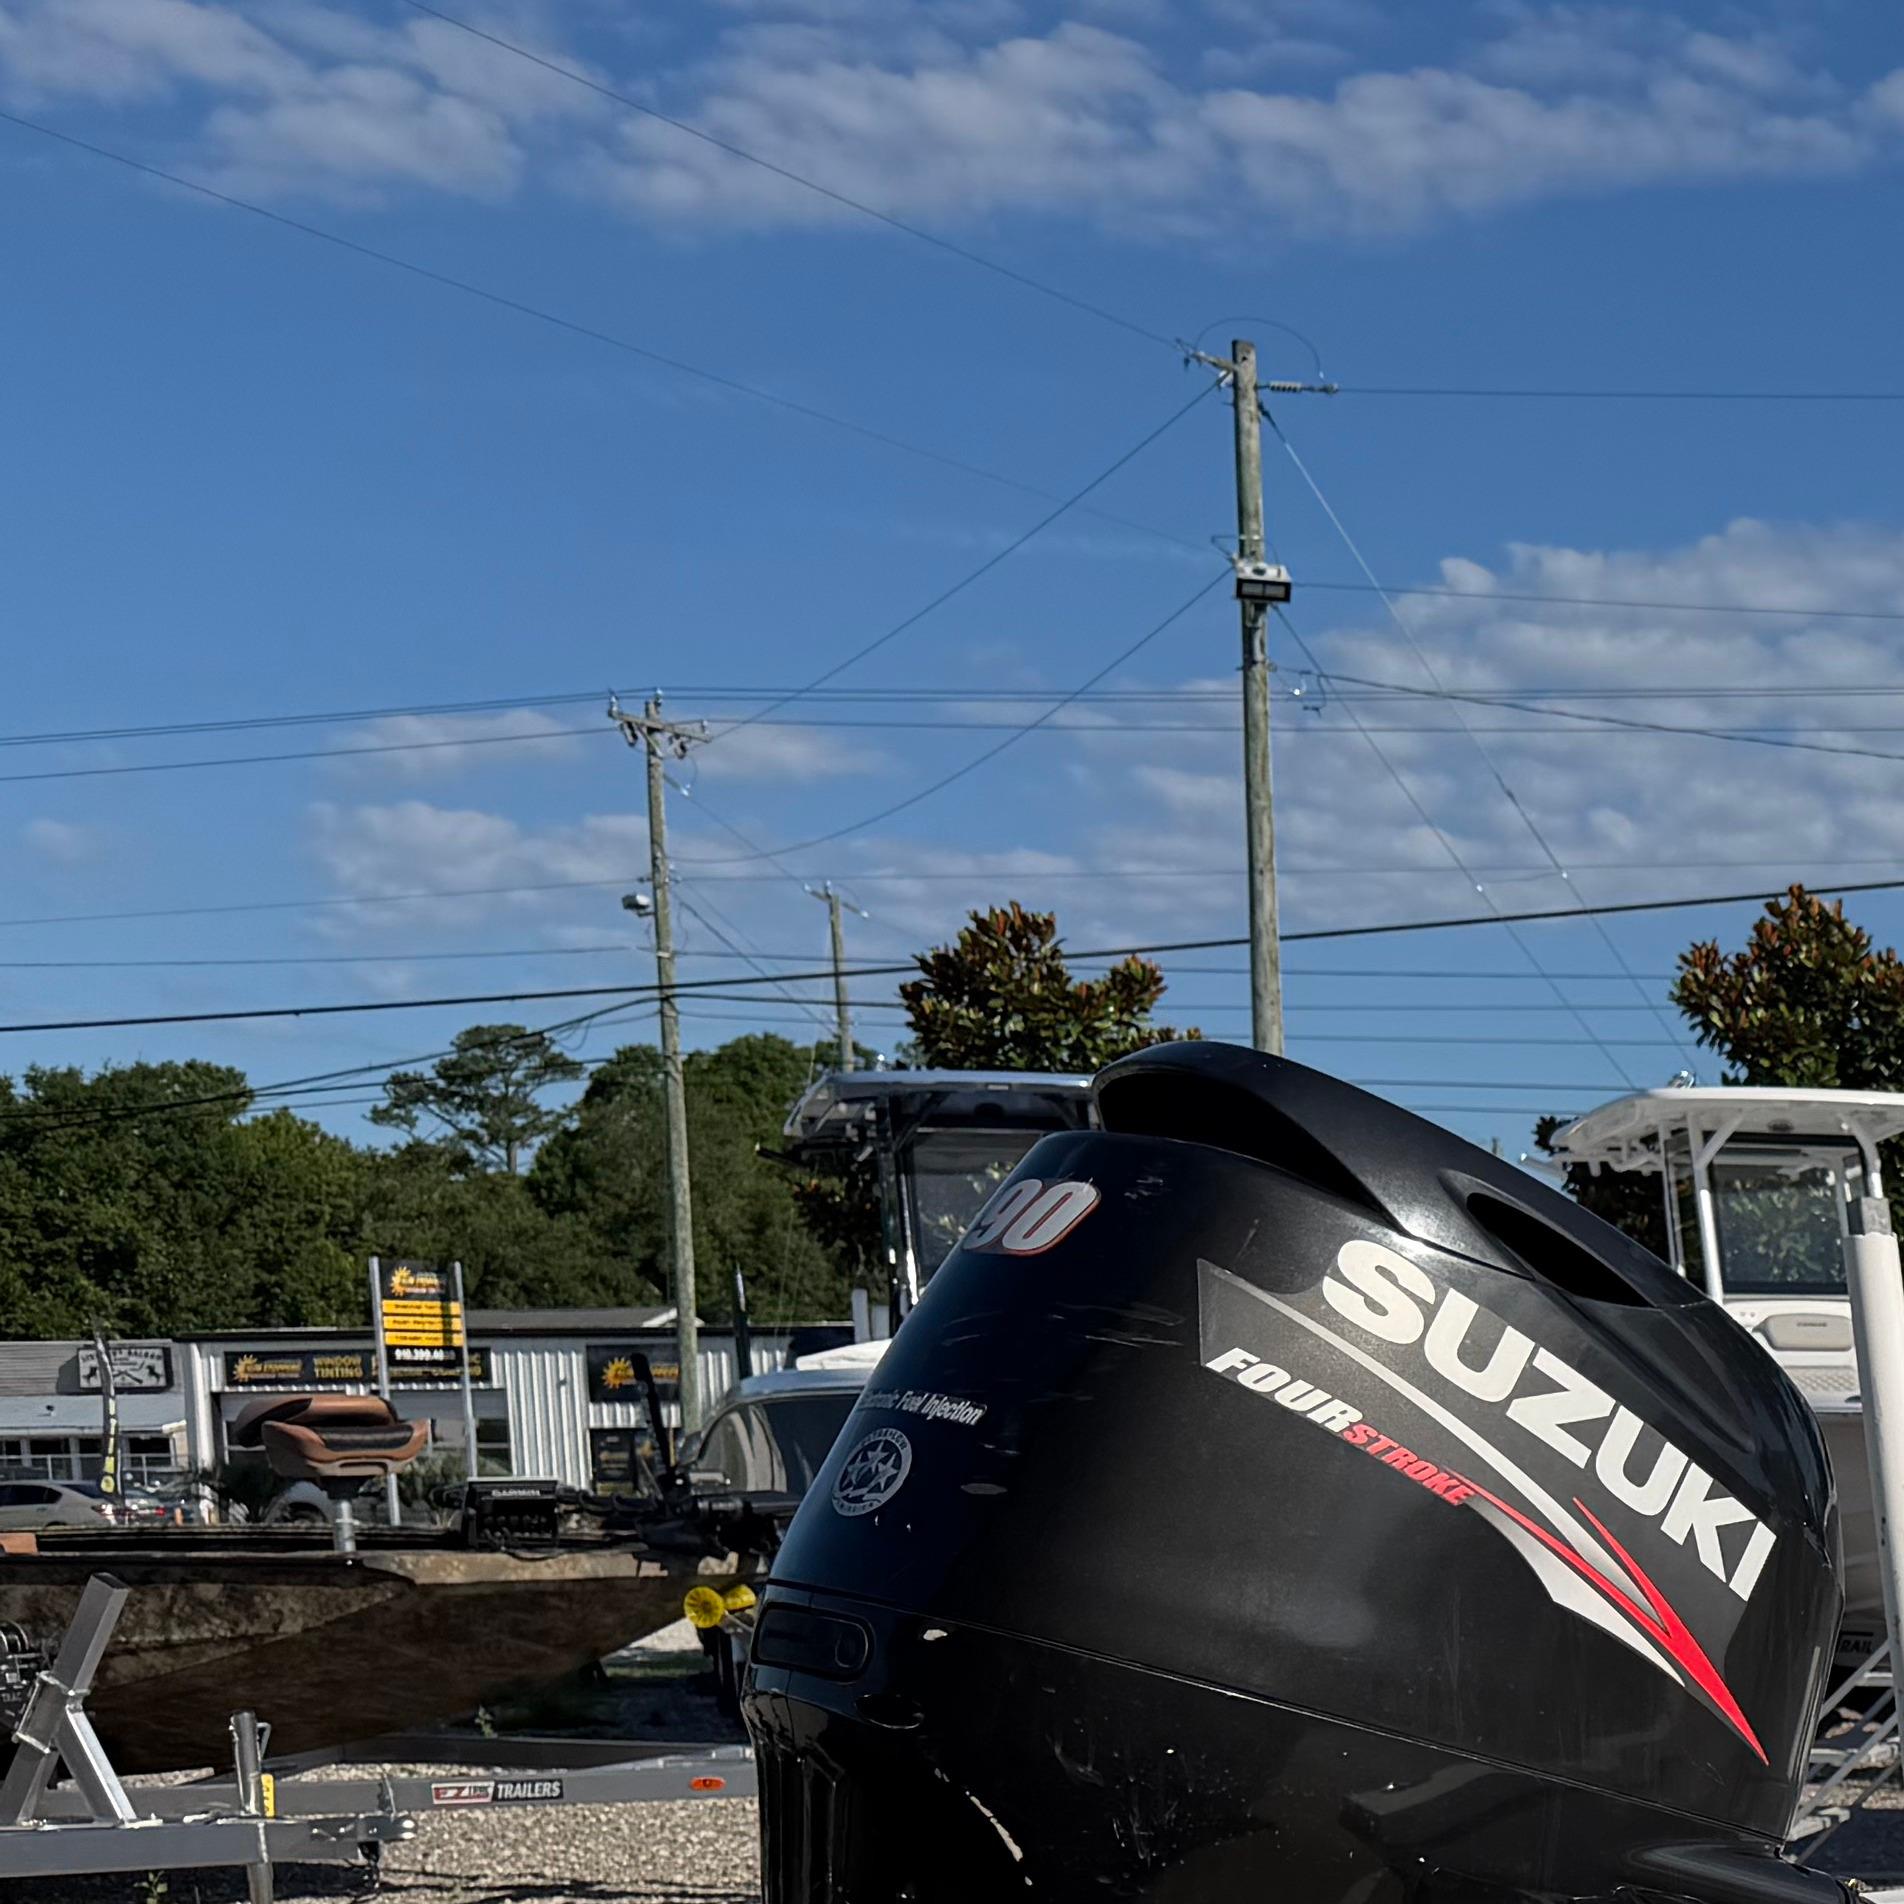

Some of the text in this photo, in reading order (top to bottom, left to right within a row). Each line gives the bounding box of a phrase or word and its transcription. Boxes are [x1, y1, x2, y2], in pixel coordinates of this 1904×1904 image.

[961, 1178, 1101, 1254] 90
[314, 1366, 363, 1379] TINTING
[896, 1390, 928, 1412] Fuel
[921, 1393, 984, 1426] Injection
[1322, 1239, 1777, 1602] SUZUKI
[497, 1781, 560, 1799] TRAILERS
